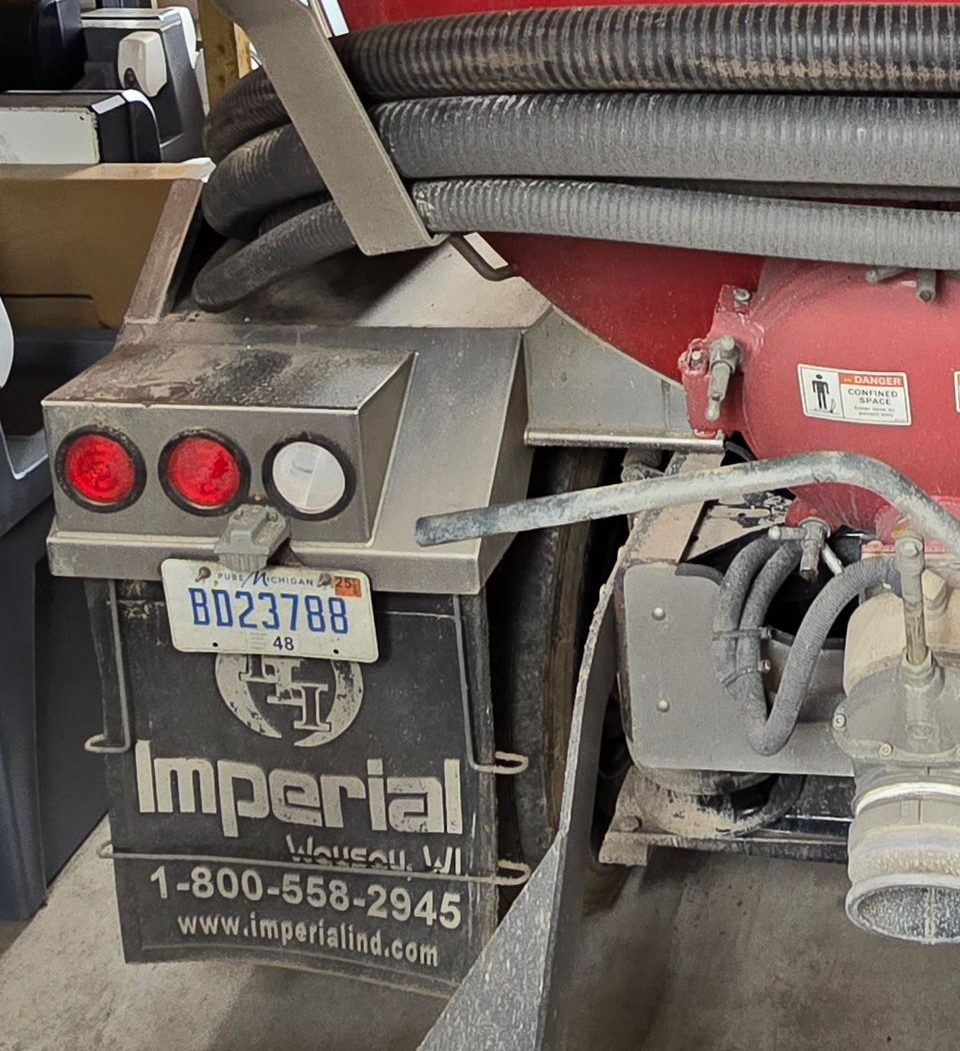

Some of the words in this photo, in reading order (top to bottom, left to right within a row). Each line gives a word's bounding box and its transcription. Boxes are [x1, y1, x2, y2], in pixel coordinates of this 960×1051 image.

[853, 375, 902, 386] DANGER
[847, 388, 898, 398] CONFINED
[859, 398, 892, 406] SPACE
[217, 572, 244, 583] PURE
[334, 575, 352, 589] 25
[188, 587, 349, 635] BD23788
[273, 636, 295, 651] 48
[135, 739, 463, 838] Imperial
[150, 864, 462, 930] 1-800-558-2945
[178, 911, 439, 968] www.imperialind.com
